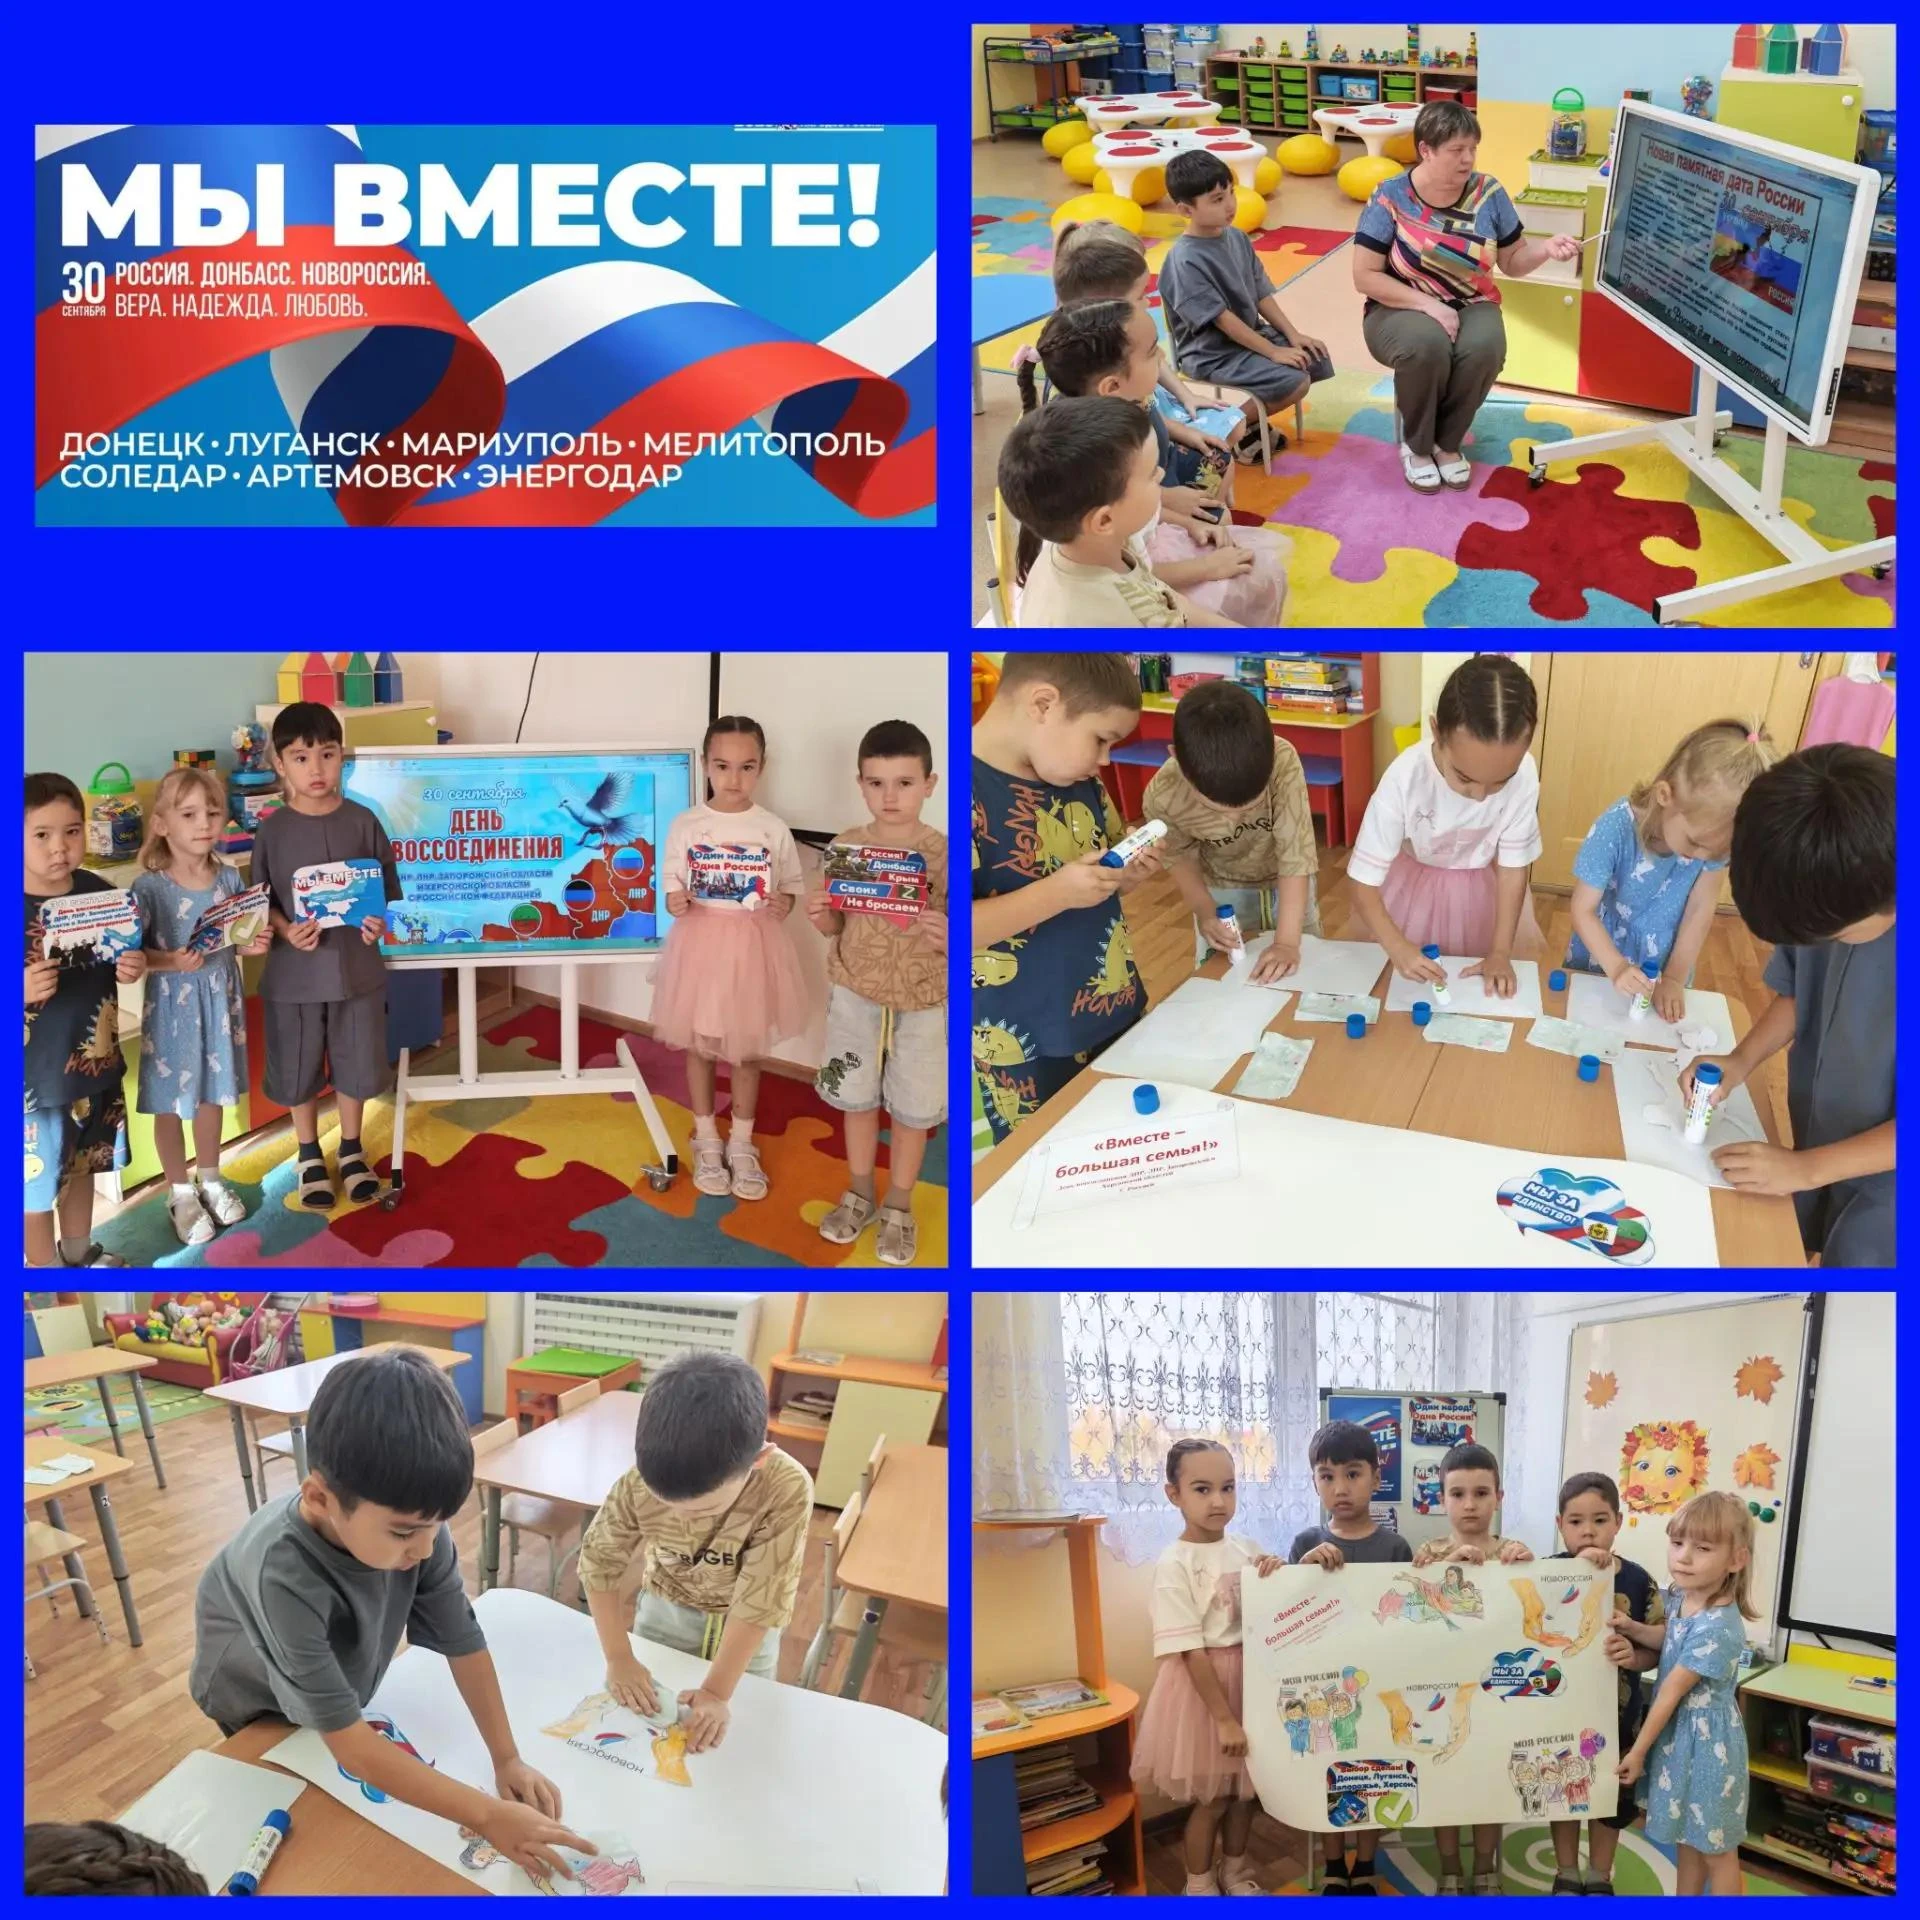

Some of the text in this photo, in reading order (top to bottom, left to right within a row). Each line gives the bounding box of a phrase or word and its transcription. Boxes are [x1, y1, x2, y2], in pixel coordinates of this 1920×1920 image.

[1646, 139, 1806, 216] Новая памятная дата России
[61, 161, 883, 248] МЫ ВМЕСТЕ!
[62, 261, 106, 304] 30
[115, 262, 431, 287] РОССИЯ. ДОНБАСС. НОВОРОССИЯ.
[62, 305, 106, 317] СЕНТЯБРЯ
[115, 293, 368, 320] ВЕРА. НАДЕЖДА. ЛЮБОВЬ.
[60, 432, 886, 460] ДОНЕЦК ЛУГАНСК МАРИУПОЛЬ МЕЛИТОПОЛЬ
[60, 463, 682, 493] СОЛЕДАР АРТЕМОВСК ЭНЕРГОДАР
[423, 780, 527, 809] 30 сентября
[450, 808, 503, 834] ДЕНЬ
[392, 836, 563, 863] ВОССОЕДИНЕНИЯ
[694, 851, 767, 863] Один народ!
[864, 849, 904, 860] Россия!
[691, 862, 768, 872] Одна Россия!
[873, 861, 917, 873] Донбасс
[888, 873, 919, 885] Крым
[628, 888, 647, 900] ЛНР
[839, 883, 878, 896] Своих
[591, 910, 611, 923] ДНР
[847, 899, 920, 914] Не бросаем
[1094, 1131, 1170, 1151] «Вместе
[1055, 1140, 1218, 1179] большая семья!»
[1525, 1182, 1578, 1210] МЫ ЗА
[1512, 1194, 1578, 1225] ЕДИНСТВО!
[1265, 1619, 1304, 1646] большая
[1406, 1682, 1460, 1691] НОВОРОССИЯ
[1537, 1733, 1575, 1745] РОССИЯ
[566, 1738, 644, 1773] НОВОРОССИЯ
